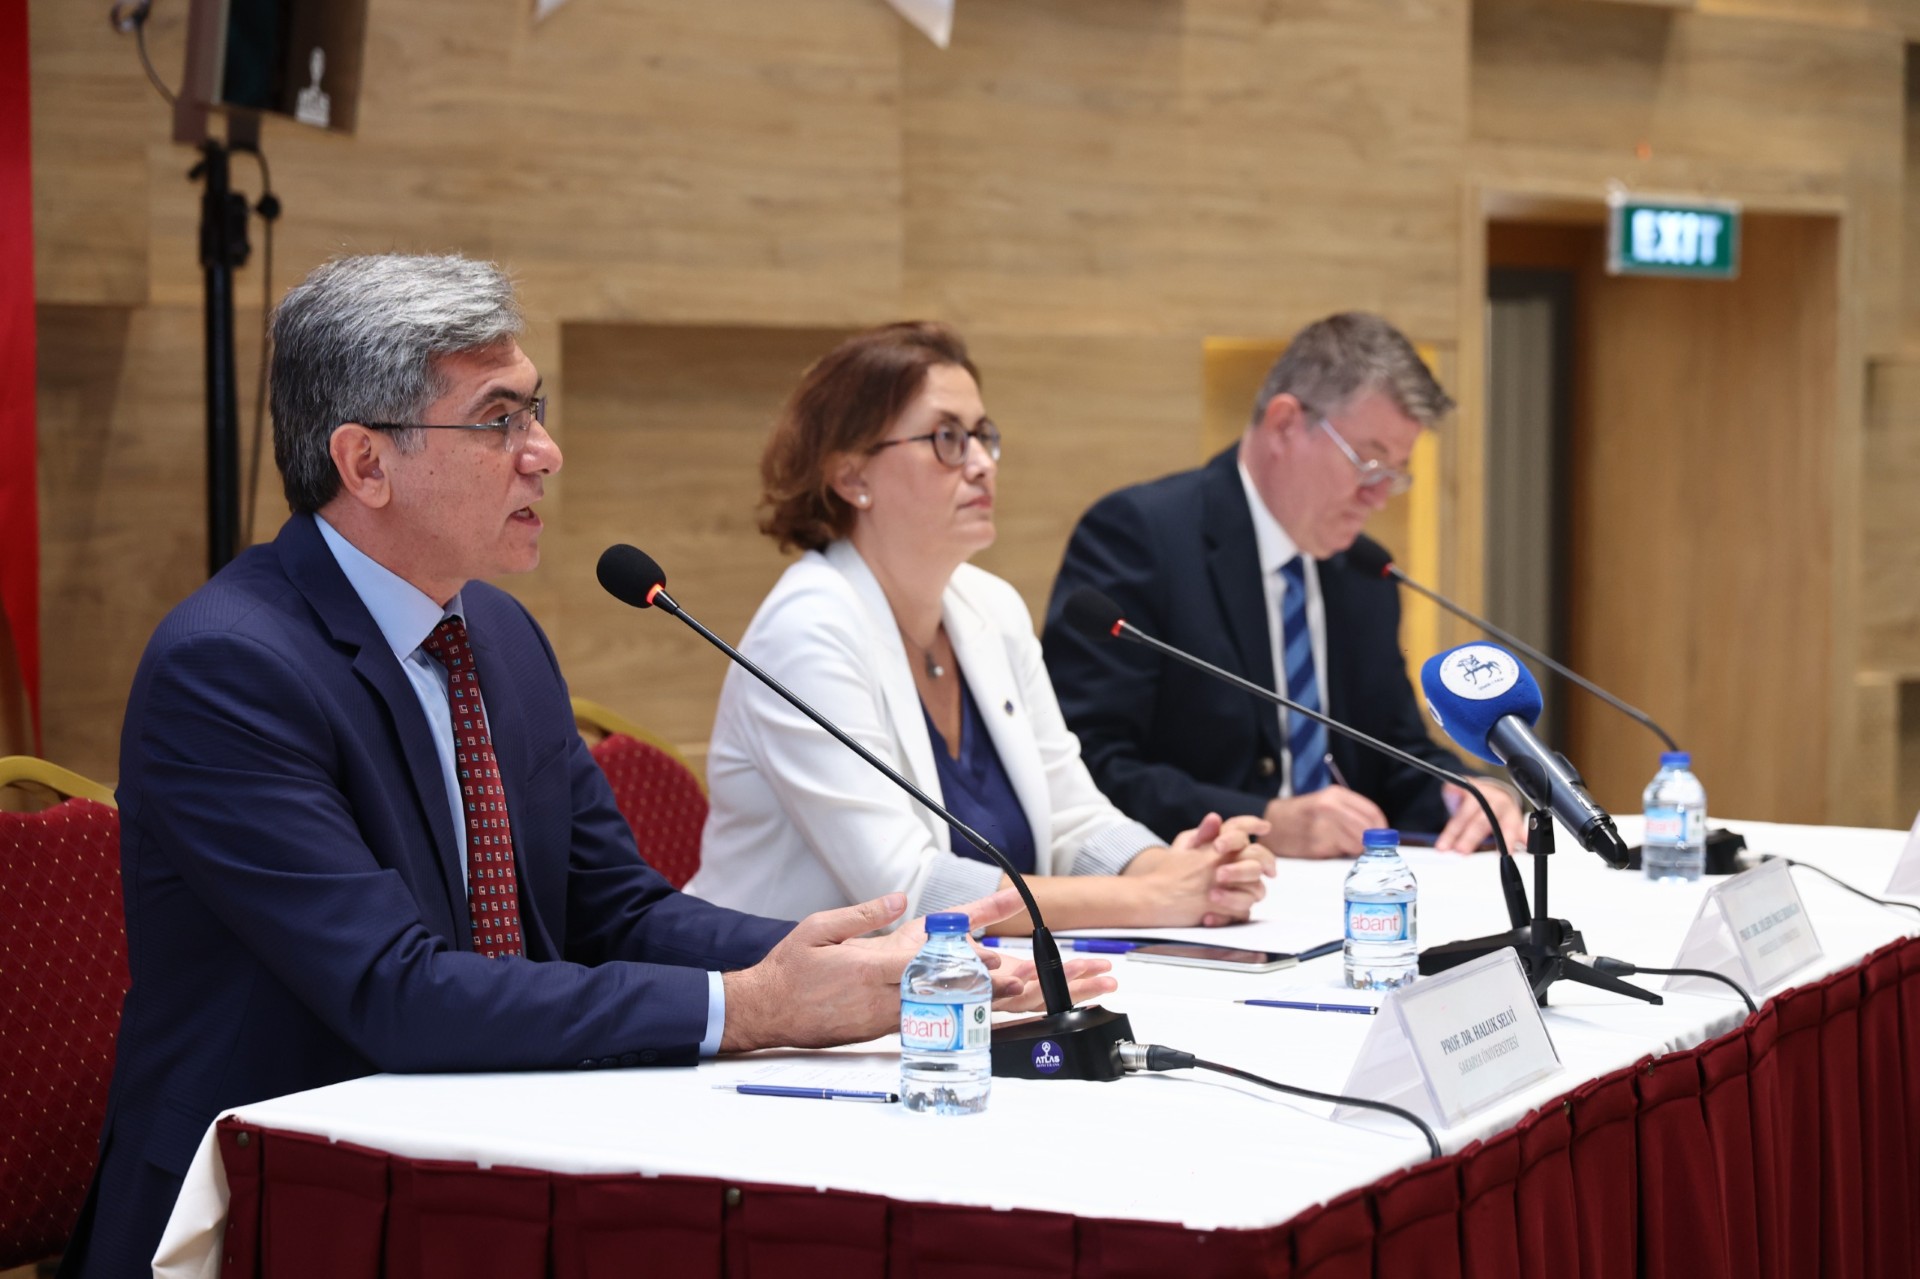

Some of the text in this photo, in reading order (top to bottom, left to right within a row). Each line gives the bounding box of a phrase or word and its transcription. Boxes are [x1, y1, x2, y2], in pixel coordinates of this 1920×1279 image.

[1632, 209, 1723, 266] EXIT
[1351, 914, 1398, 931] abant
[903, 1015, 950, 1038] abant
[1440, 1034, 1464, 1055] PROF.
[1472, 1016, 1499, 1040] HALUK
[1496, 1005, 1517, 1029] SELVİ
[1036, 1055, 1060, 1063] ATLAS
